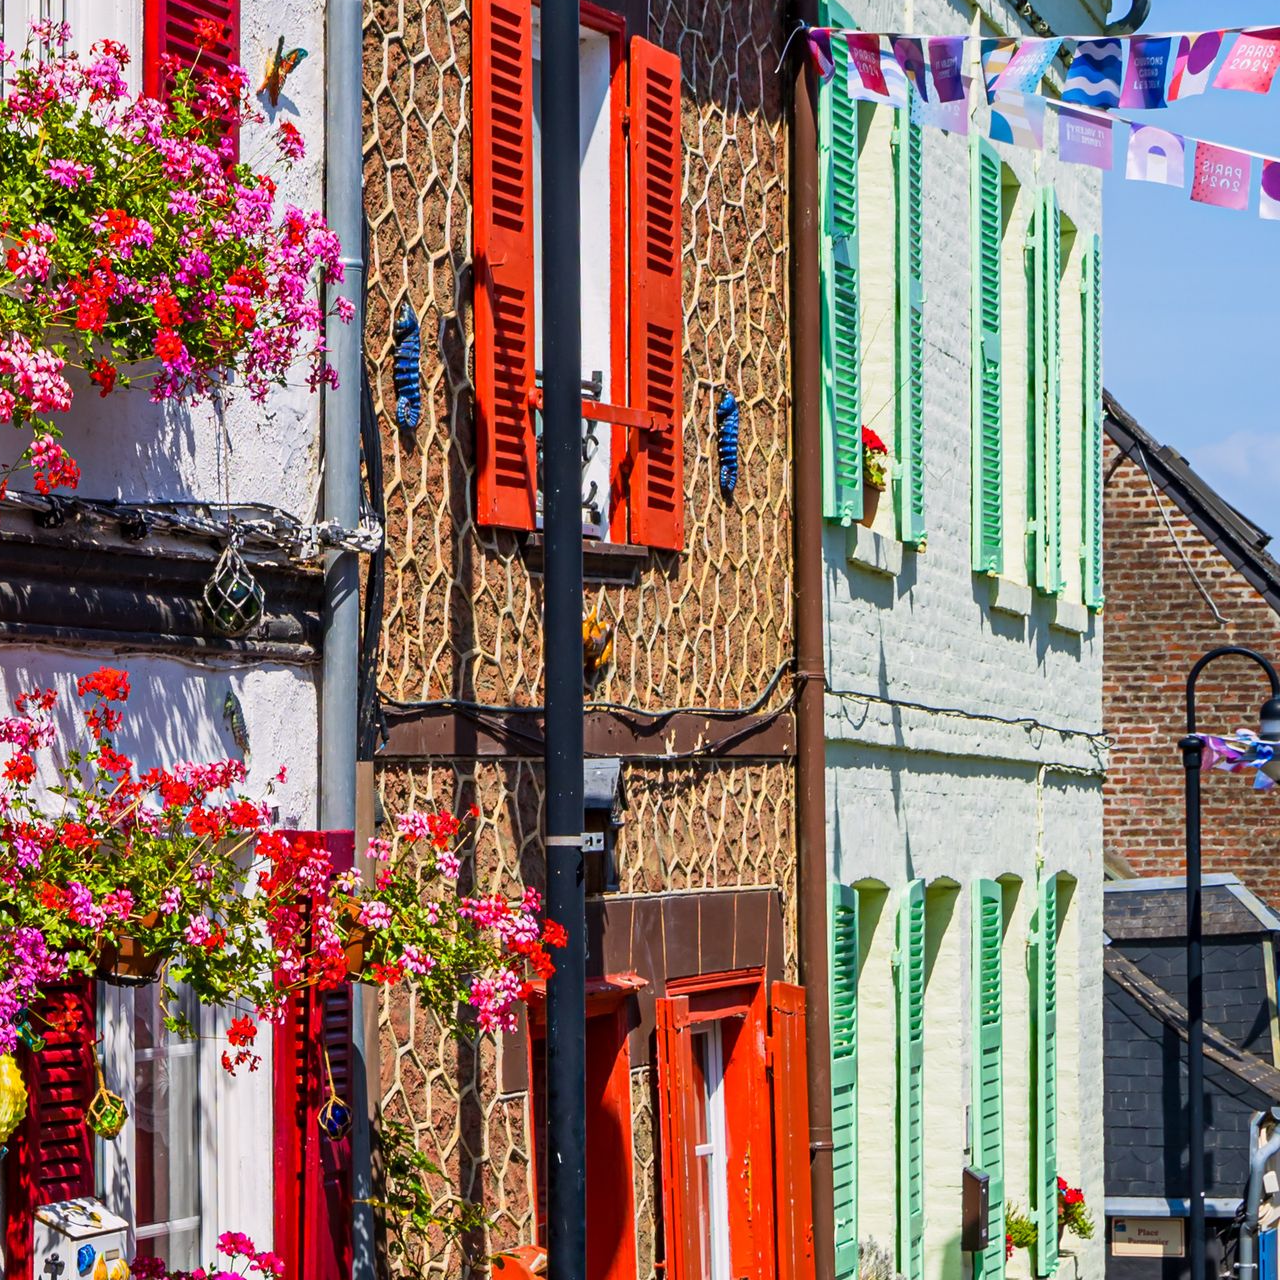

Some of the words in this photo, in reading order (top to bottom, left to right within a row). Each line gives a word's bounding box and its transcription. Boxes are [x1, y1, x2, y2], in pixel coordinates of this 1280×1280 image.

[857, 61, 879, 78] 2024
[1229, 58, 1269, 72] 2024
[1137, 1228, 1159, 1236] Place
